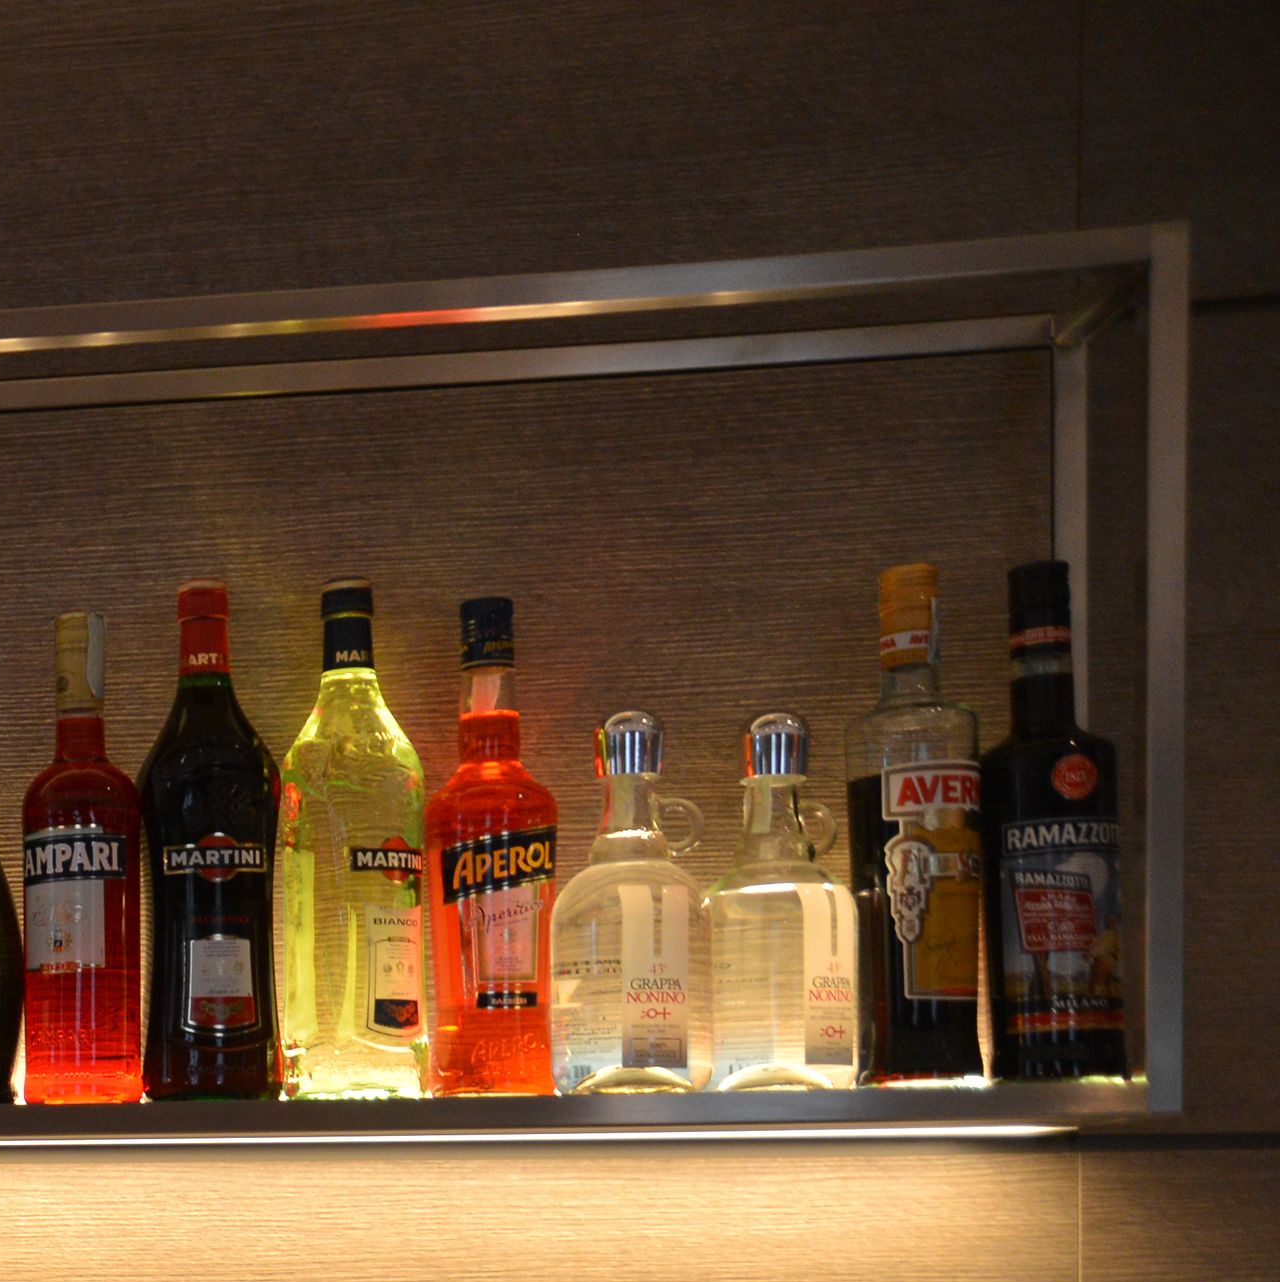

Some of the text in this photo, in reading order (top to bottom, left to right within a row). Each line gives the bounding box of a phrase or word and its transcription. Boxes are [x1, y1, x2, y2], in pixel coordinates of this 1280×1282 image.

[25, 840, 120, 878] AMPARI
[171, 849, 261, 867] MARTINI
[356, 850, 422, 871] MARTINI
[452, 840, 553, 890] APEROL
[373, 917, 418, 927] BIANCO
[630, 978, 682, 991] GRAPPA
[812, 975, 851, 989] GRAPPA
[626, 991, 686, 1004] NONINO
